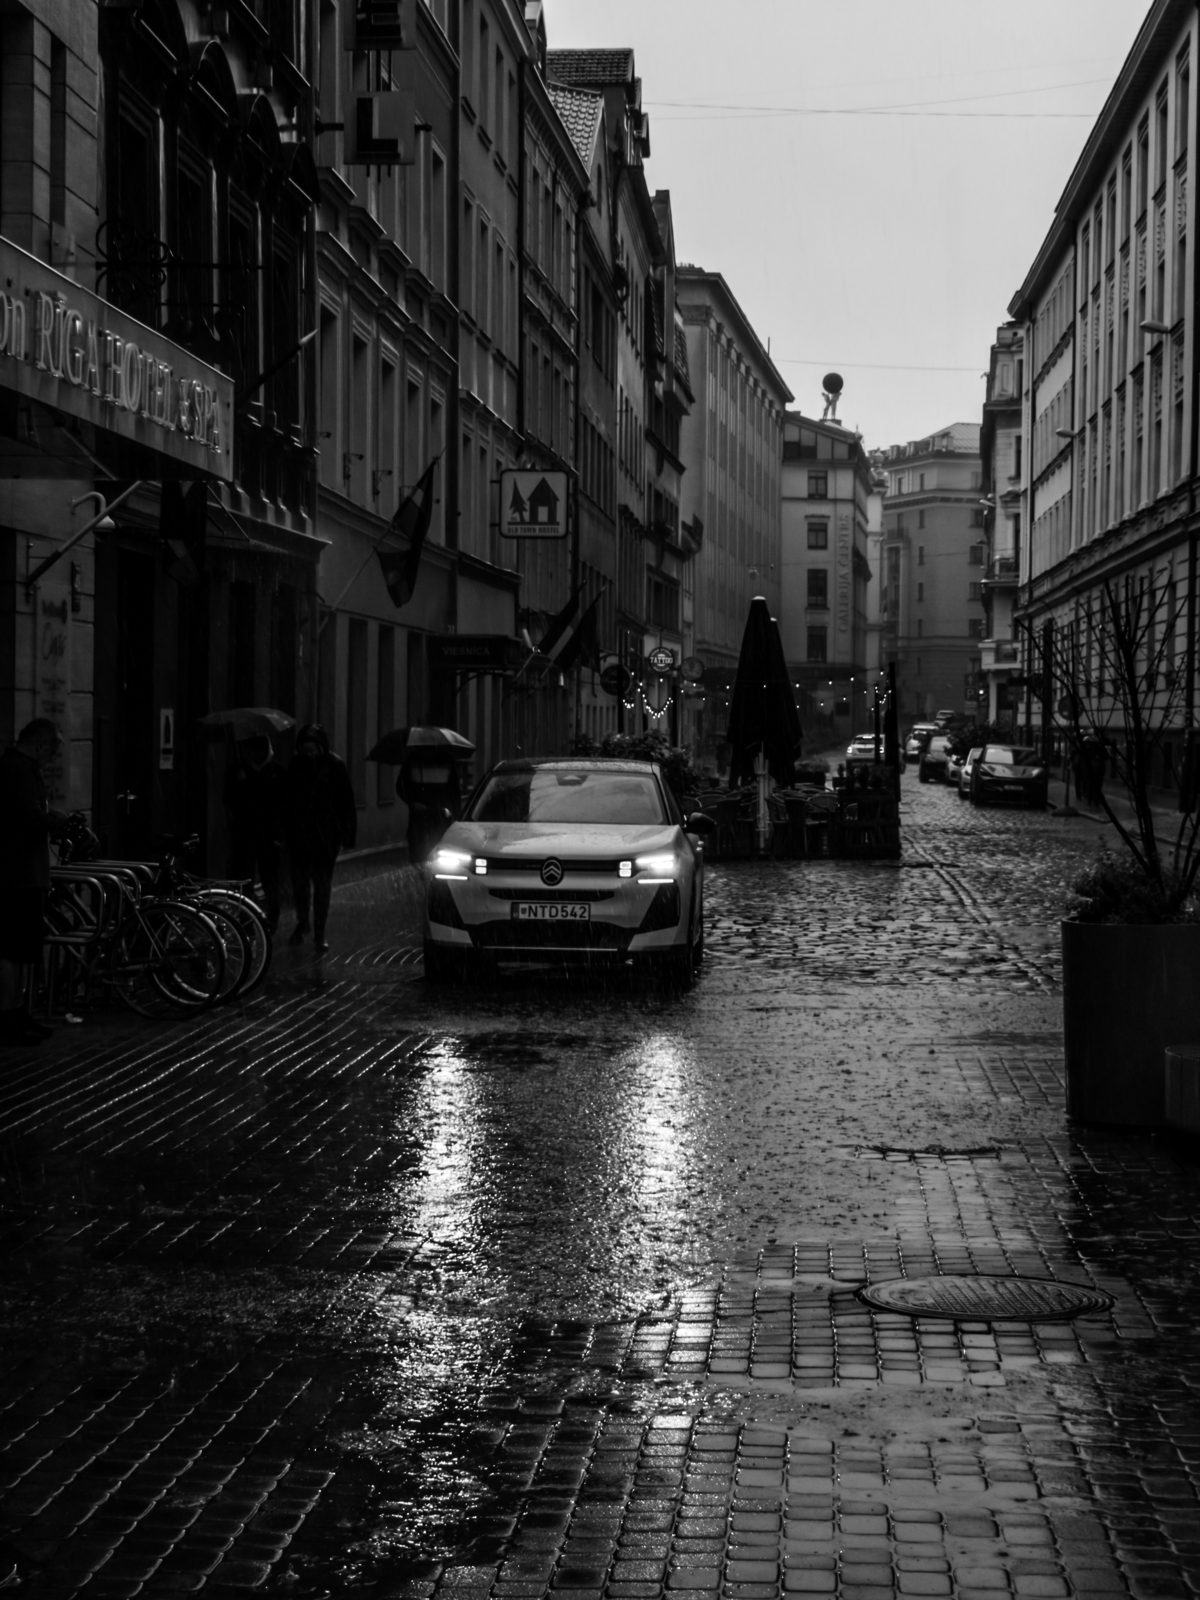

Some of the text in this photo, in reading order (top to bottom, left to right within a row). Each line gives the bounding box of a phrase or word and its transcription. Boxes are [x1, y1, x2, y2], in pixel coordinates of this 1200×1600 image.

[103, 329, 176, 431] HOTEL
[192, 379, 222, 453] SPA
[520, 526, 537, 534] TOWN
[539, 526, 559, 534] HOSTEL
[838, 514, 850, 634] GALERIJA CENTRS
[649, 656, 674, 664] TATTOO
[528, 905, 587, 918] NTD542
